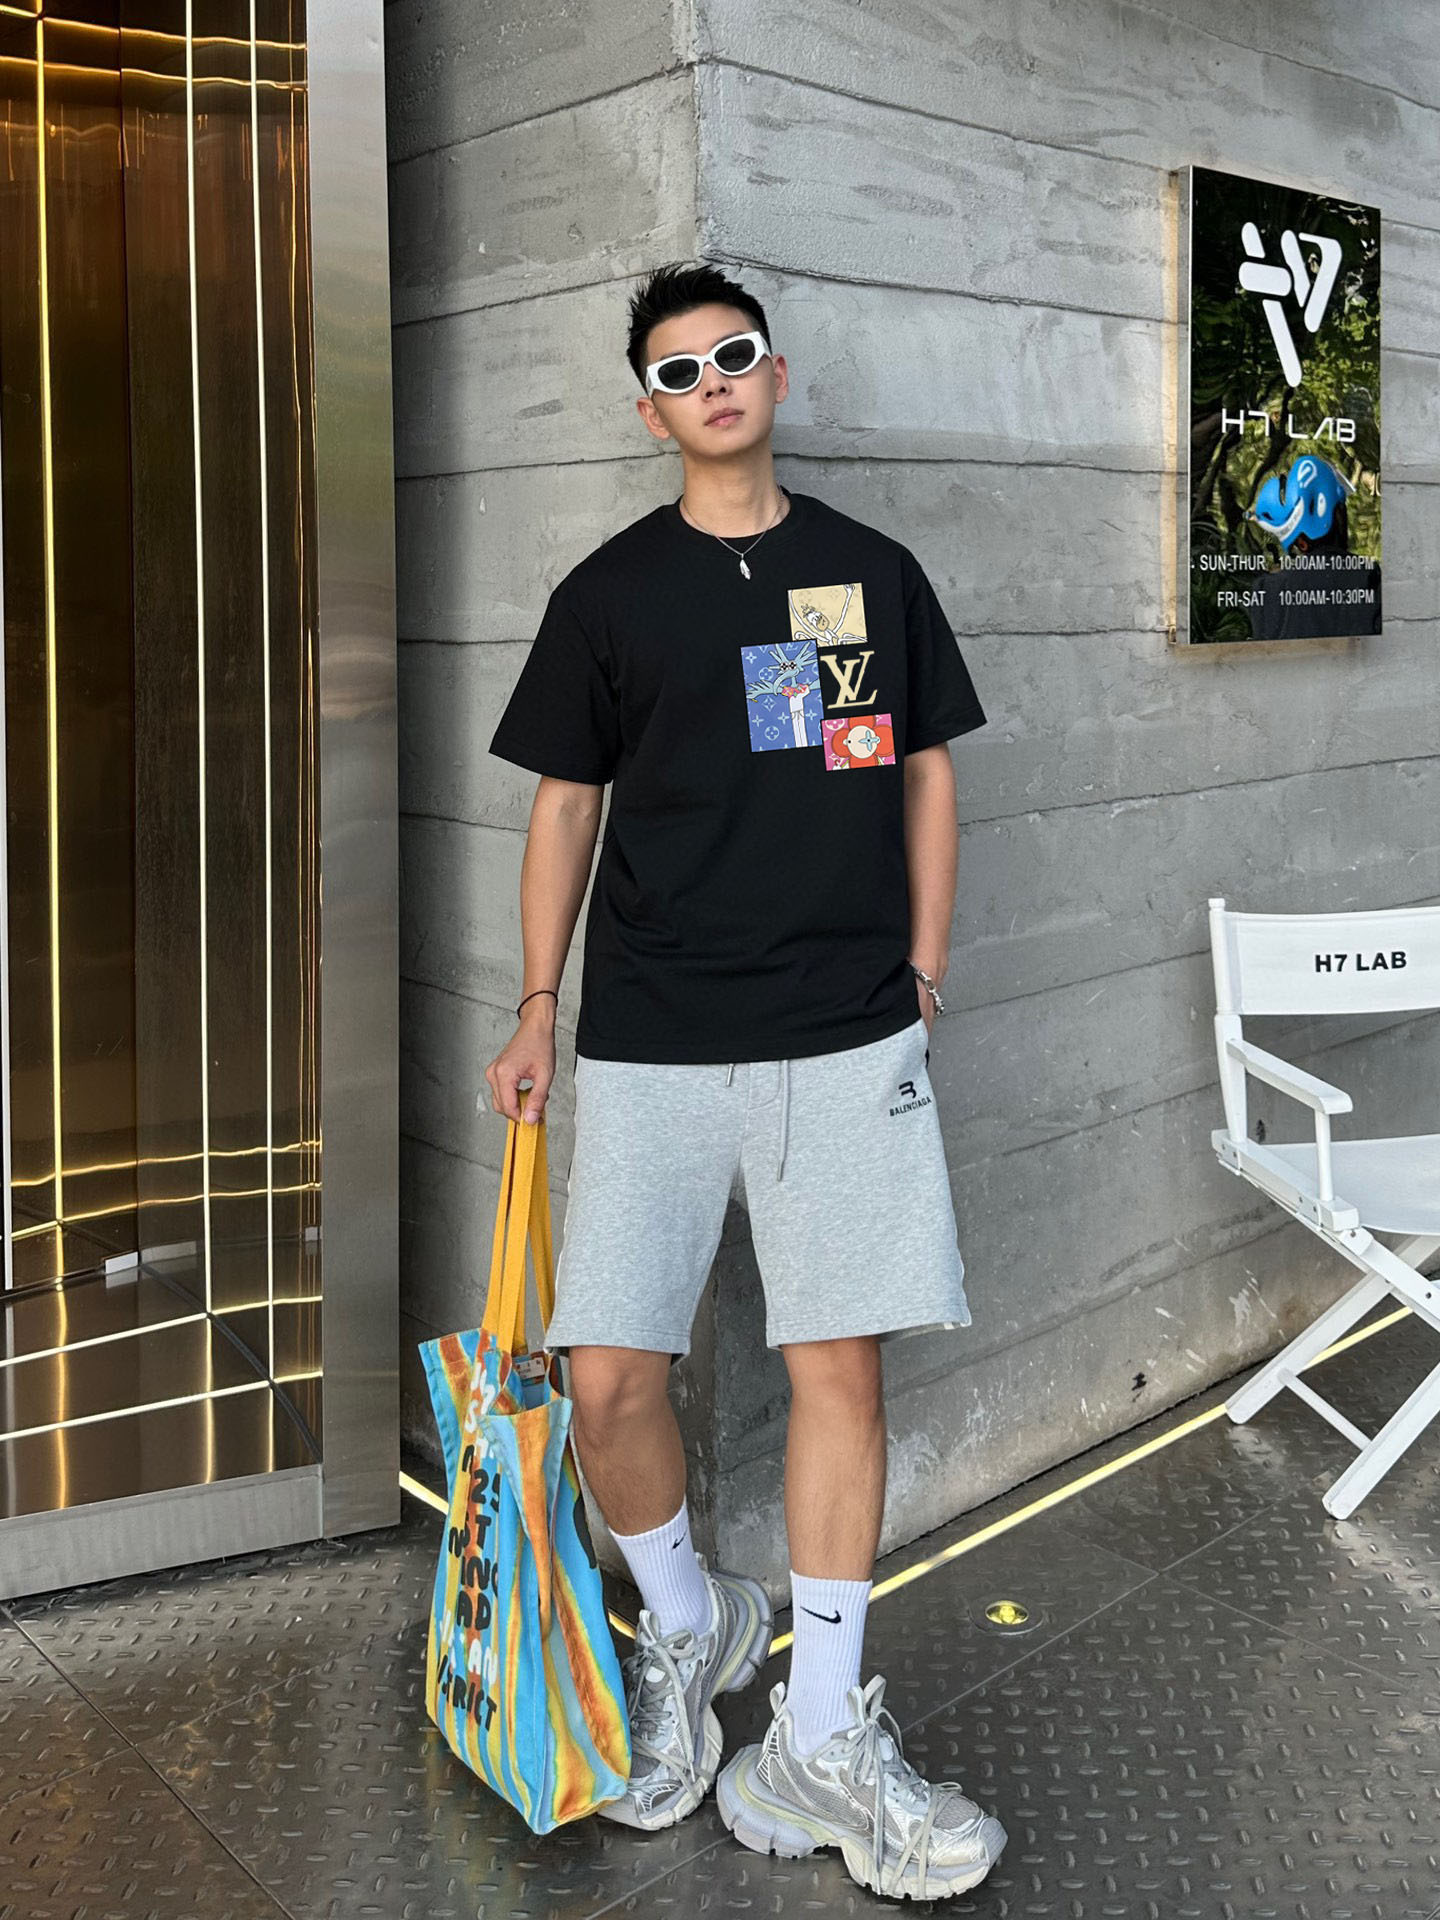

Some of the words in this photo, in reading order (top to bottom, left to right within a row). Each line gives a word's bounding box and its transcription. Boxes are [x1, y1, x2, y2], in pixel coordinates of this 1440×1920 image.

[1221, 408, 1270, 437] H7
[1288, 414, 1356, 442] LAB
[1199, 554, 1266, 571] SUN-THUR
[1279, 555, 1375, 571] 10:00AM-10:00PM
[1217, 590, 1266, 607] FRI-SAT
[1279, 589, 1375, 605] 10:00AM-10:30PM
[1315, 954, 1348, 973] H7
[1356, 951, 1407, 971] LAB
[889, 1096, 932, 1117] BALENCIAGA
